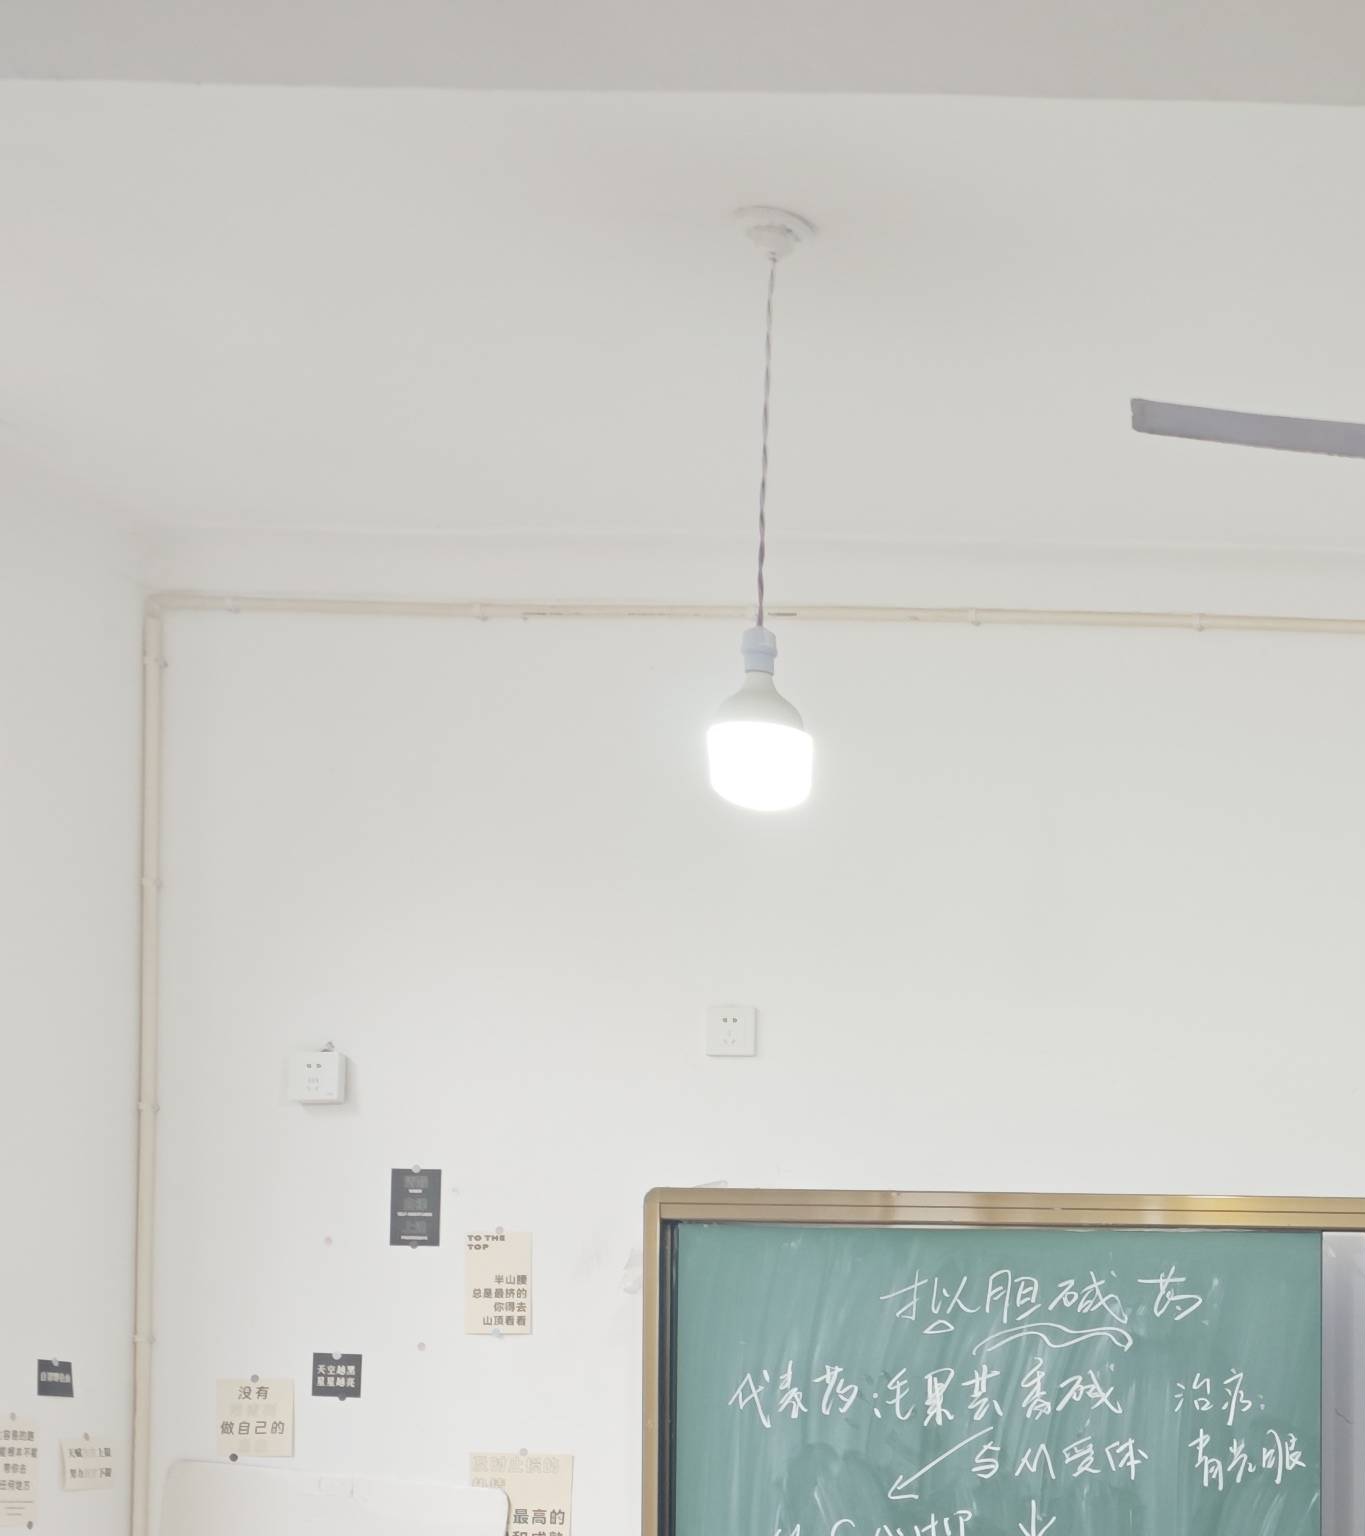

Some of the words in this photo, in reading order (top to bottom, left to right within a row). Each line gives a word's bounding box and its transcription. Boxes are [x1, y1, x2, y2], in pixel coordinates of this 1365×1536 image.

[494, 1275, 527, 1285] 半山腰
[472, 1288, 527, 1299] 总是最挤的
[493, 1302, 527, 1312] 你得去
[483, 1316, 526, 1326] 山顶看看
[238, 1386, 269, 1400] 没有
[221, 1421, 285, 1435] 做自己的
[513, 1509, 565, 1525] 最高的
